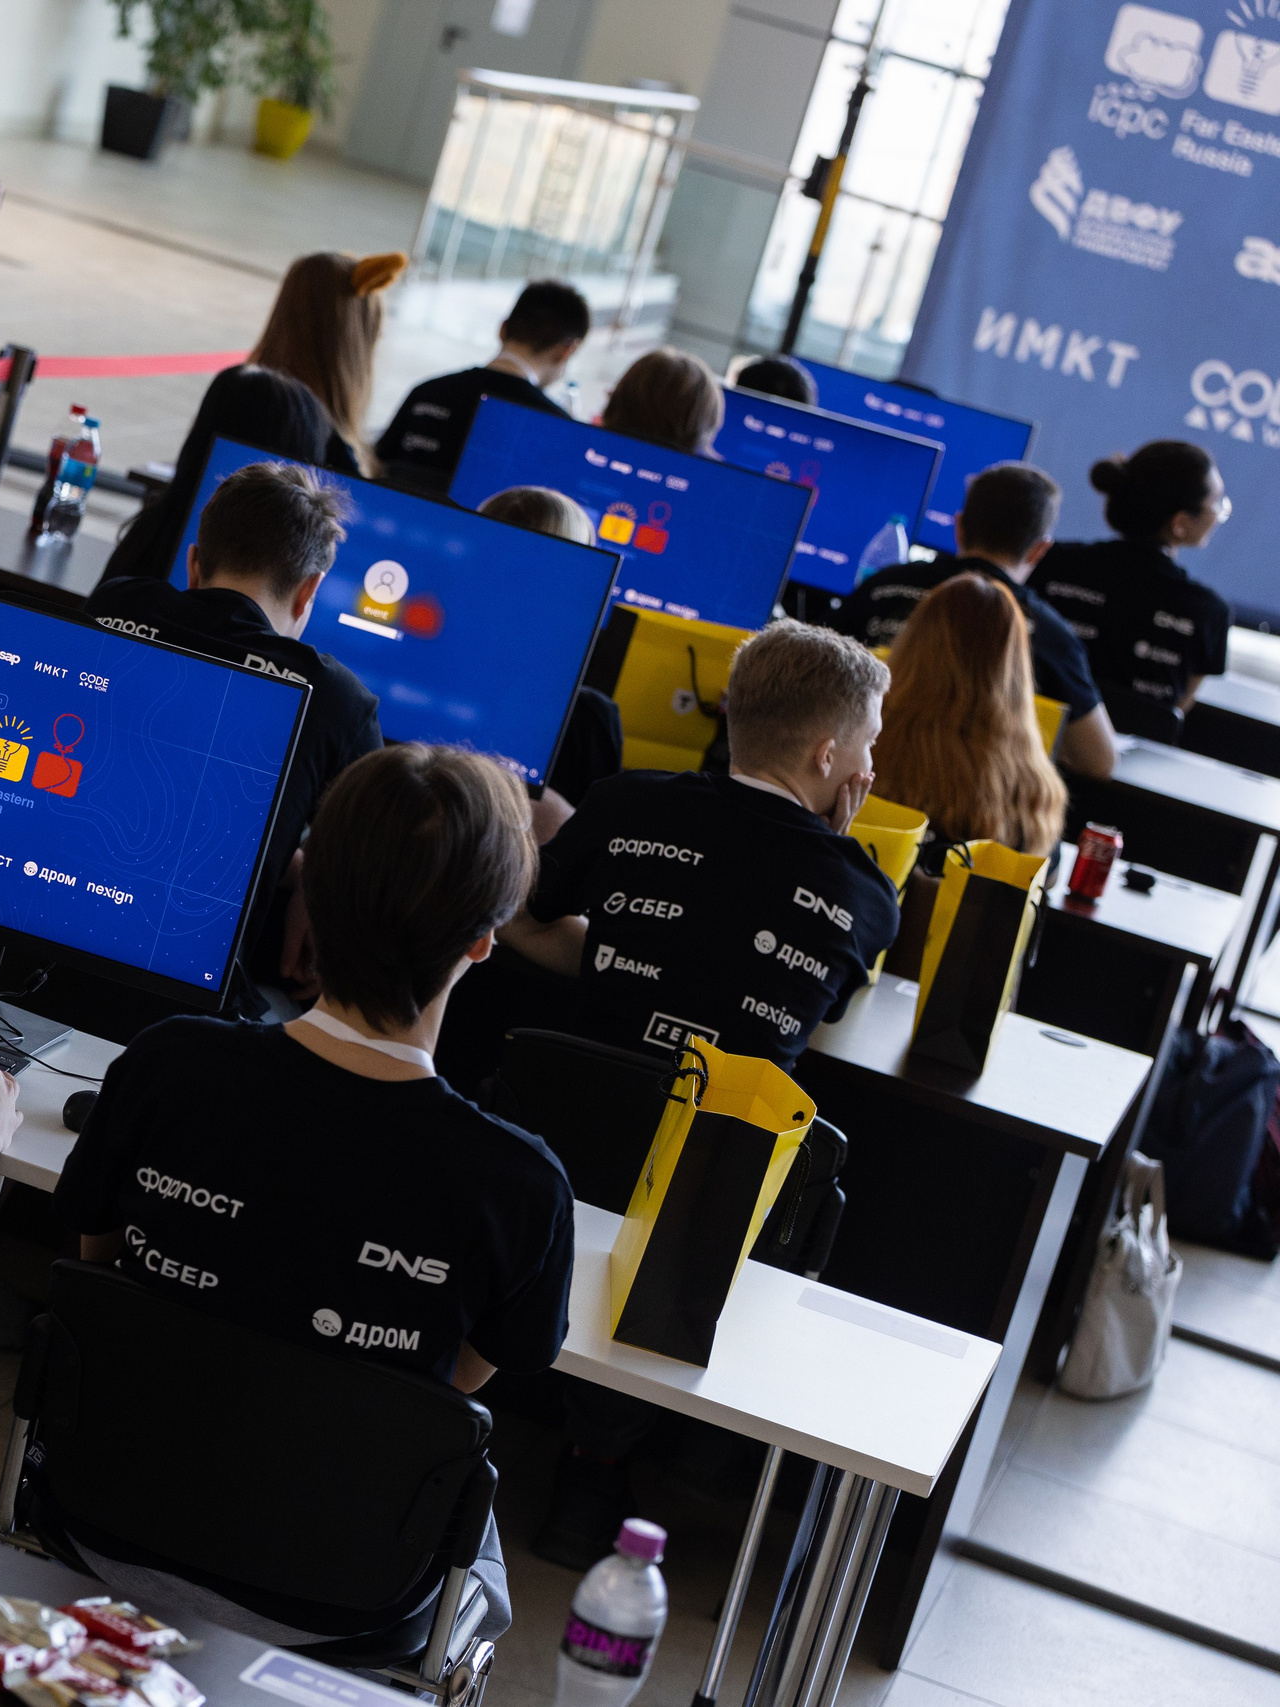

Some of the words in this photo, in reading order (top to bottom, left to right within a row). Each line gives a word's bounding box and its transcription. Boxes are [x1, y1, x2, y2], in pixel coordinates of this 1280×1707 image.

[973, 304, 1141, 389] ИМКТ
[34, 661, 68, 679] ИМКТ
[79, 671, 110, 688] CODE
[608, 836, 704, 866] фарпост
[38, 867, 77, 887] дром
[86, 881, 134, 905] nexign
[629, 898, 684, 920] СБЕР
[793, 886, 854, 932] DNS
[614, 956, 663, 980] БАНК
[776, 943, 830, 981] дром
[741, 995, 802, 1036] nexign
[136, 1167, 244, 1218] фарпост
[145, 1249, 219, 1289] СБЕР
[357, 1241, 450, 1285] DNS
[344, 1321, 421, 1351] дром
